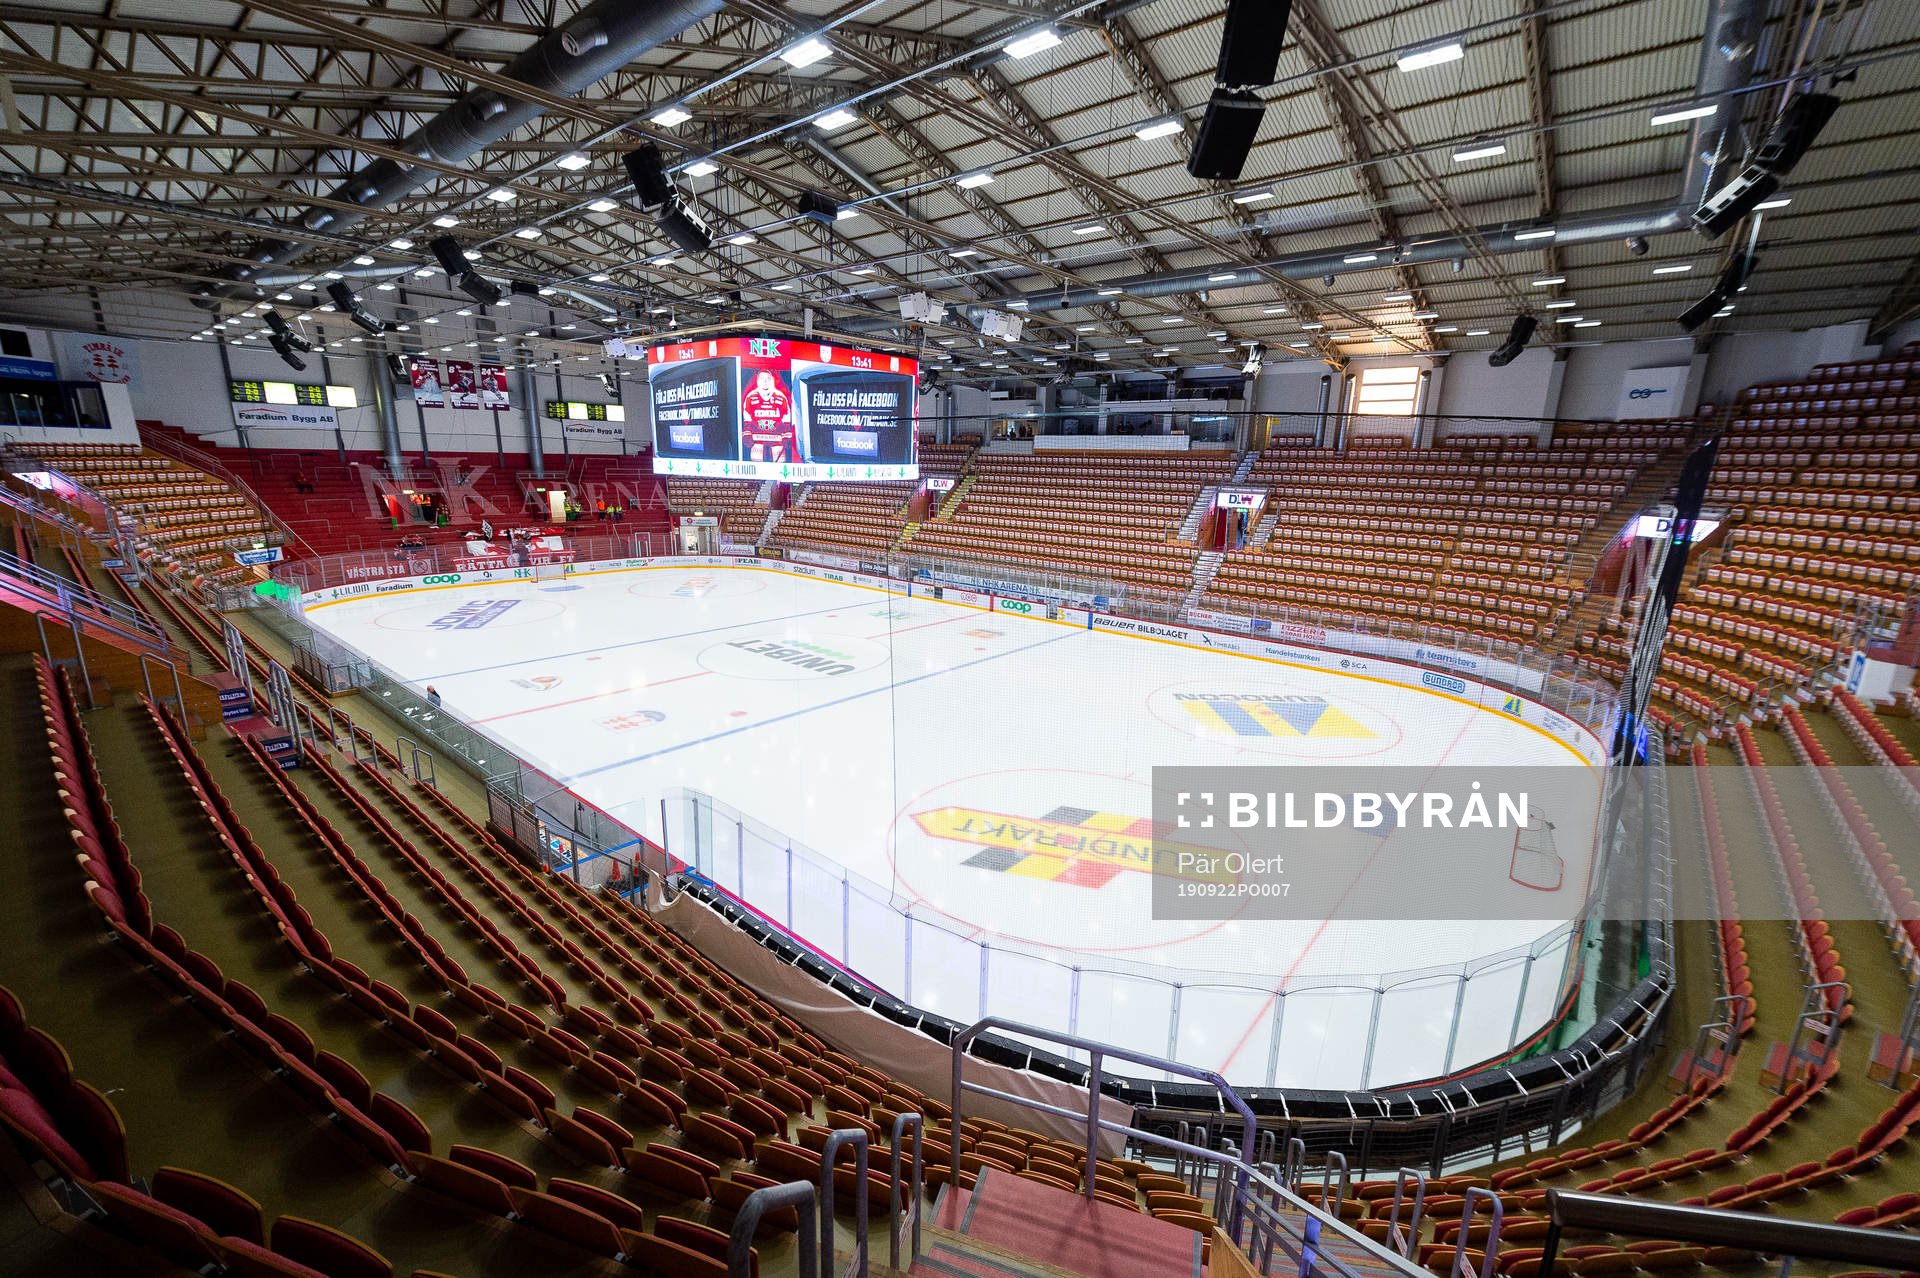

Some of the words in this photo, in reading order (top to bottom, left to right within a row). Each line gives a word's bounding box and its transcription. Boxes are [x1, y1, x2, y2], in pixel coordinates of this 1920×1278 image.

[685, 380, 719, 401] FACEBOOK
[858, 392, 899, 407] FACEBOOK
[239, 412, 287, 421] Faradium
[291, 414, 317, 423] Bygg
[319, 415, 334, 423] AB
[672, 431, 701, 444] facebook
[837, 437, 874, 450] facebook
[456, 559, 505, 572] RÄTTA
[529, 555, 575, 566] VIRET
[346, 564, 384, 579] VÄSTRA
[793, 566, 816, 575] stadium
[423, 573, 461, 585] coop
[339, 583, 370, 596] LILIUM
[376, 583, 413, 592] Faradium
[999, 581, 1028, 592] ARENA
[1001, 599, 1032, 613] coop
[1093, 617, 1136, 631] BAUER
[1281, 624, 1327, 637] PIZZERIA
[1137, 624, 1188, 640] BILBOLAGET
[725, 639, 856, 676] UNIBET
[1265, 647, 1321, 663] Handelsbanken
[1427, 651, 1477, 669] teamsters
[1351, 662, 1368, 670] SCA
